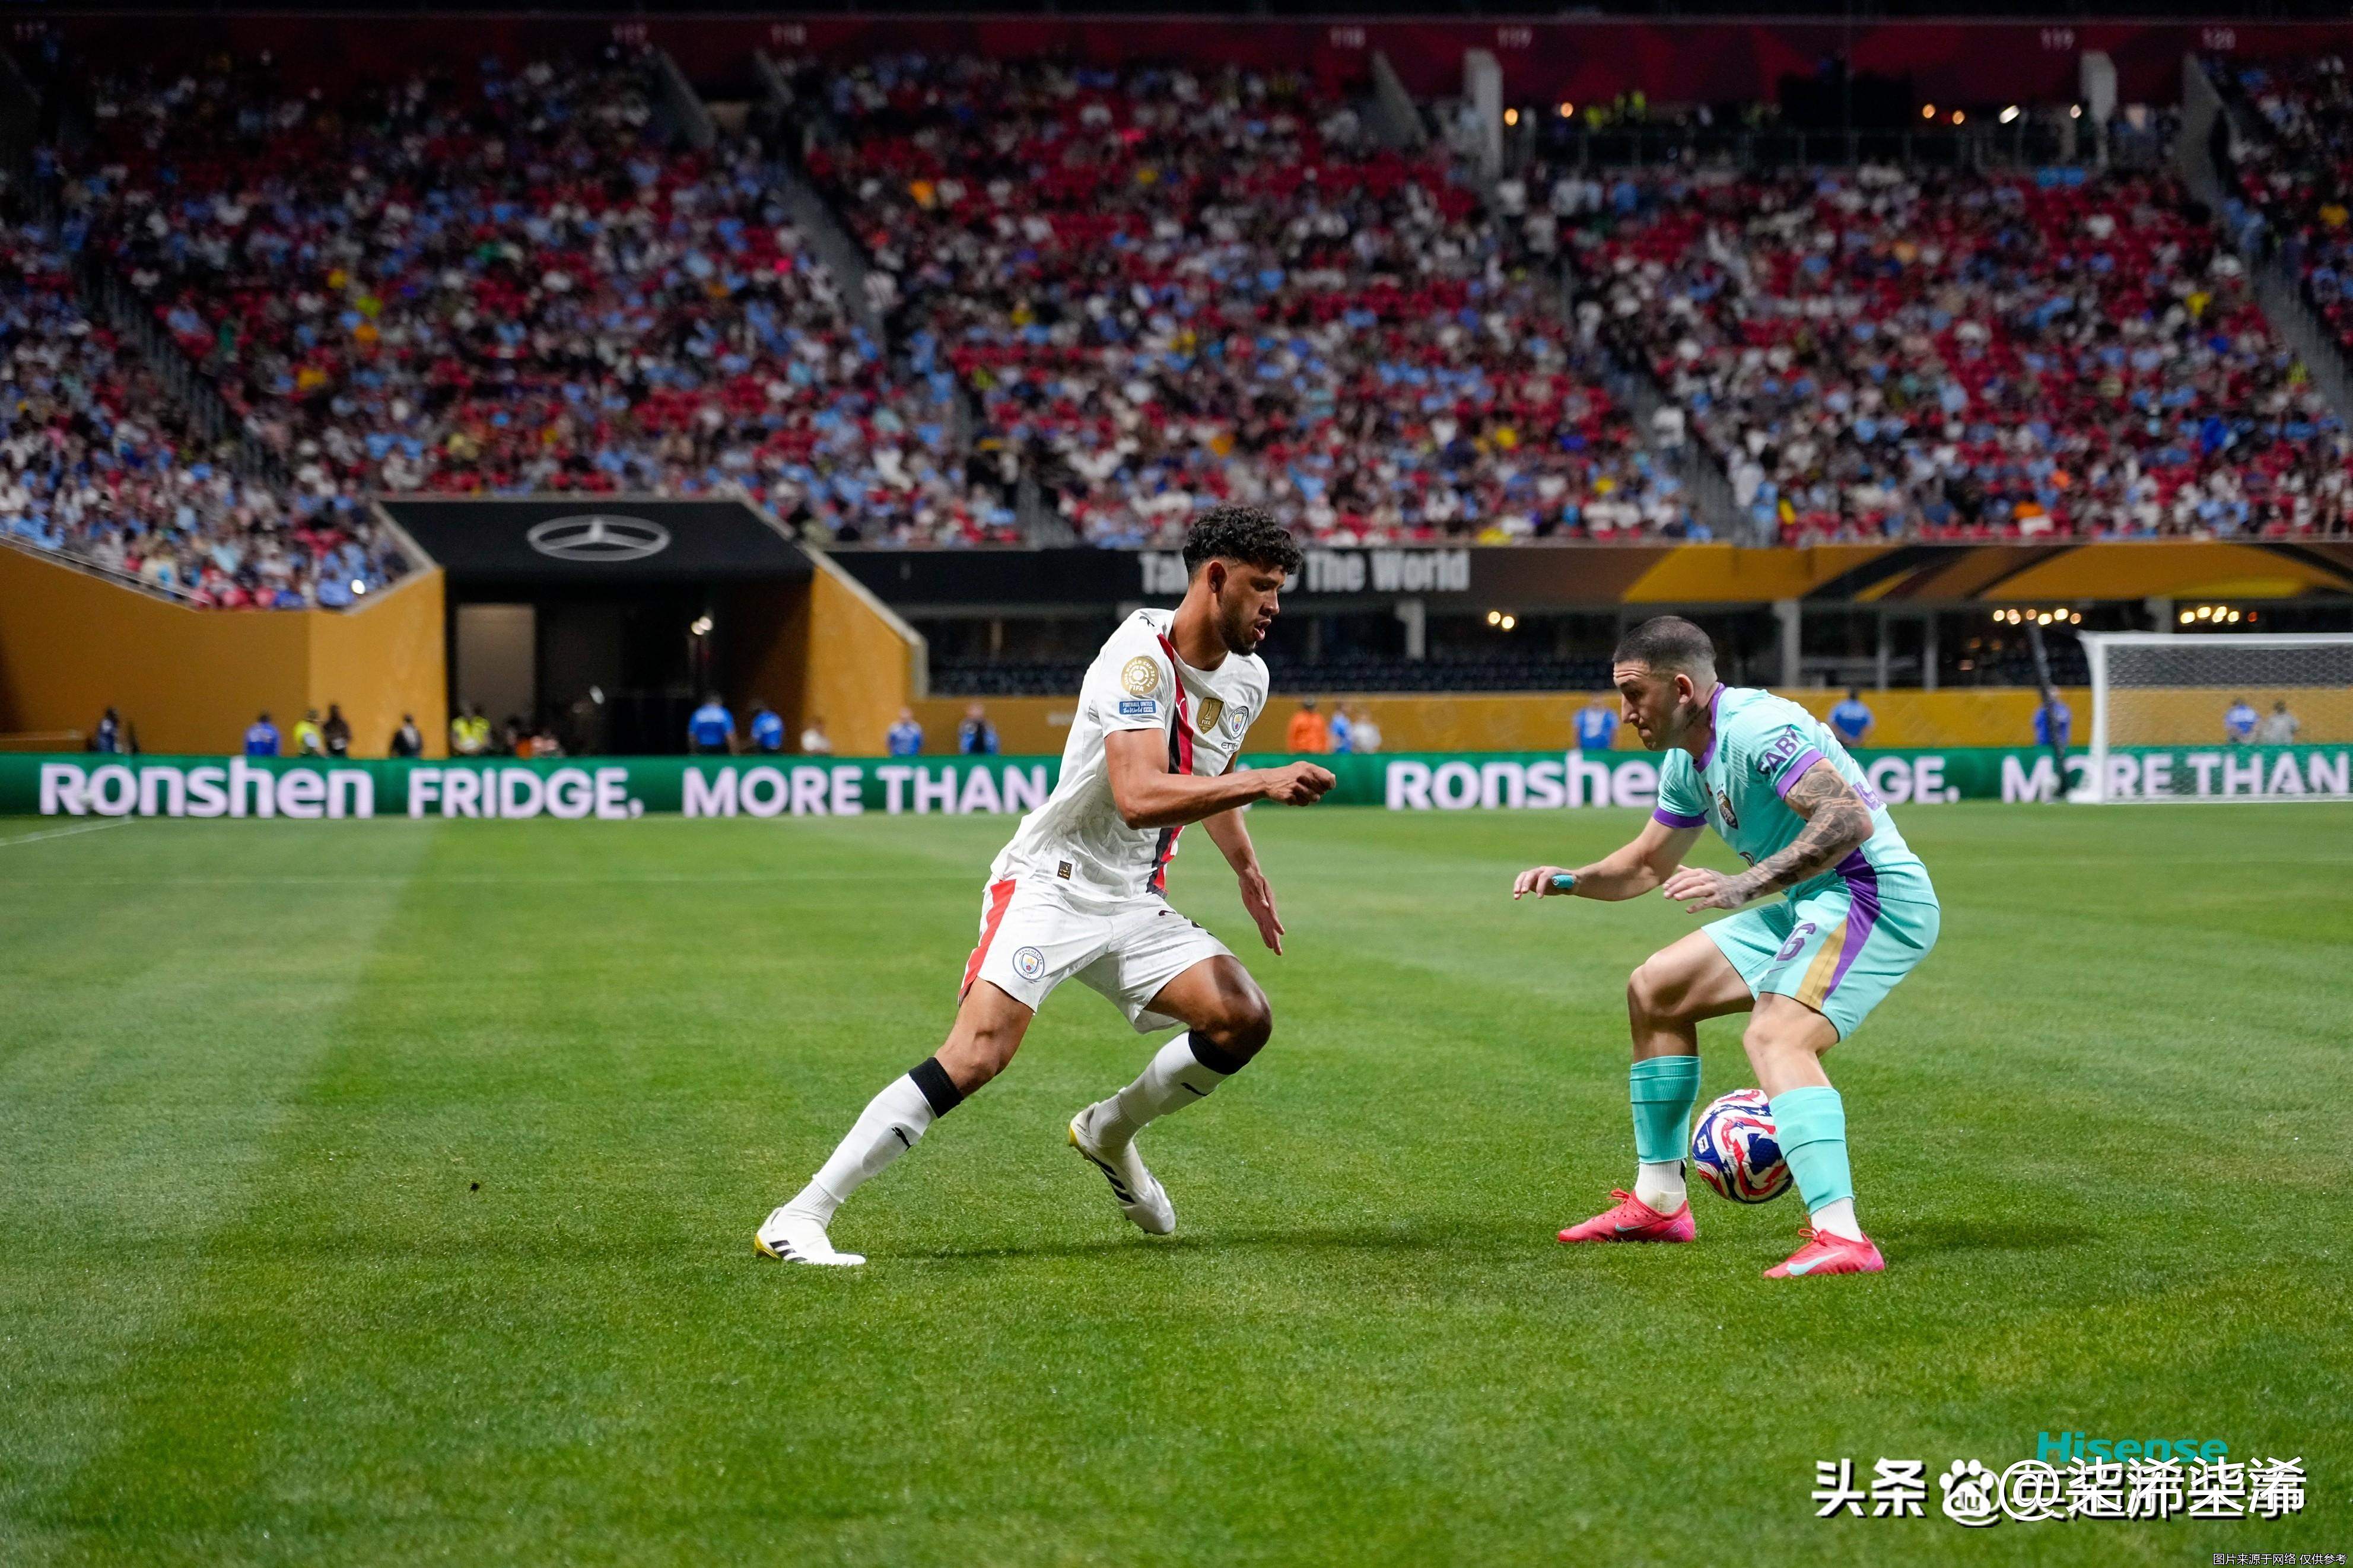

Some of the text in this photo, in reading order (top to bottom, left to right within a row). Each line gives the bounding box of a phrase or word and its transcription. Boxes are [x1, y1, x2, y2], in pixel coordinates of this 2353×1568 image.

[1305, 550, 1363, 593] The
[1372, 550, 1470, 591] World
[683, 765, 863, 818] MORE
[876, 764, 1048, 815] THAN
[1385, 749, 1664, 810] Ronshe
[2186, 751, 2349, 797] THAN
